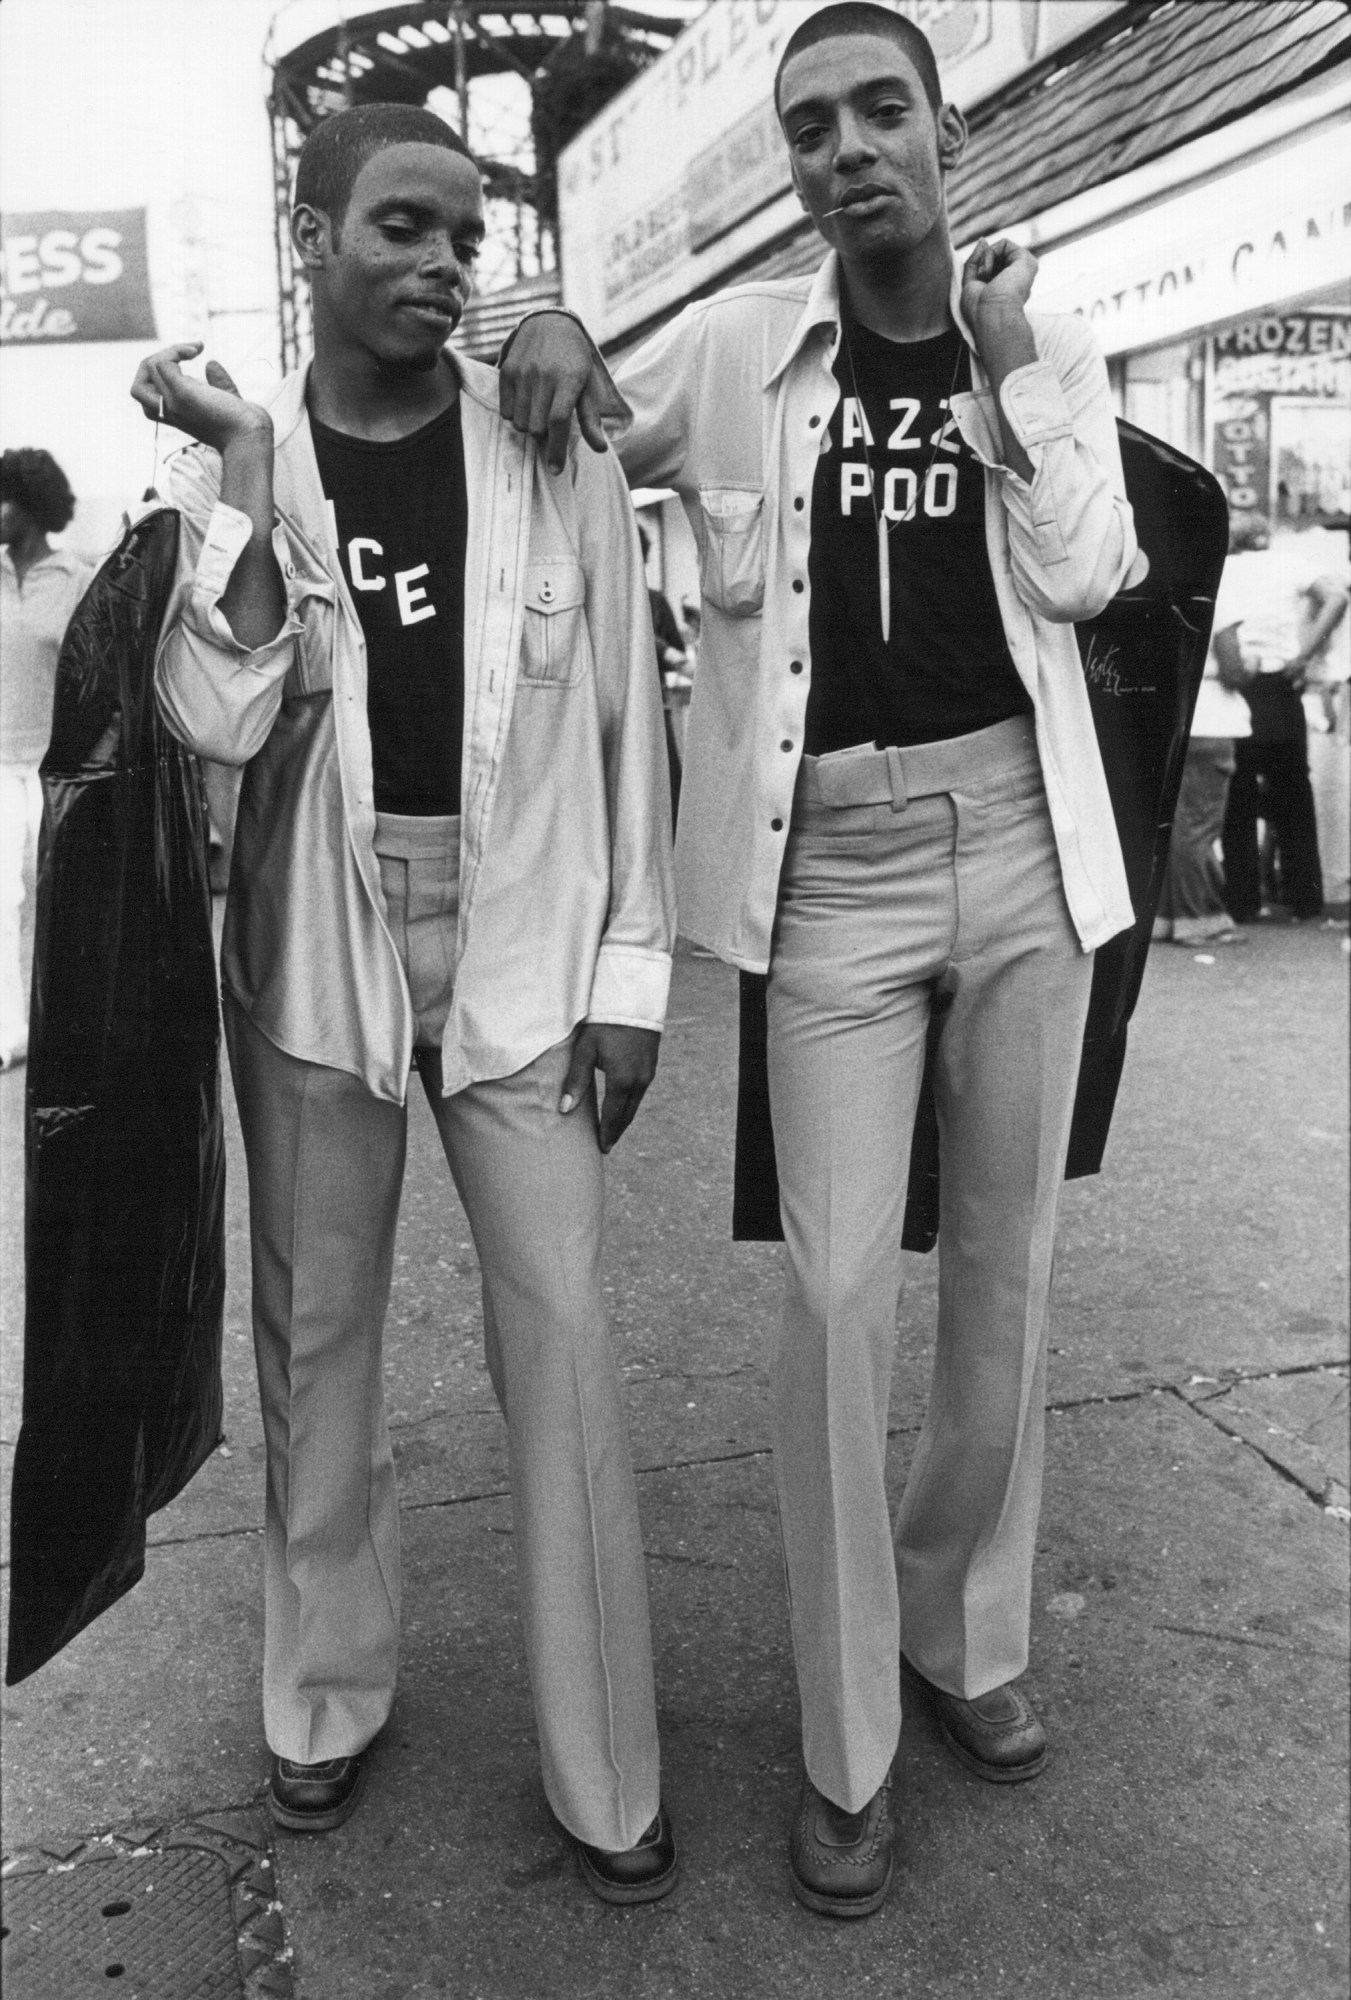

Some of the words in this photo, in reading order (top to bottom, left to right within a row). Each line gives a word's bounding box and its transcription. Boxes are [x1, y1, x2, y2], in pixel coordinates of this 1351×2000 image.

[0, 227, 123, 295] ESS
[1230, 201, 1351, 284] CAN
[840, 462, 958, 521] POO
